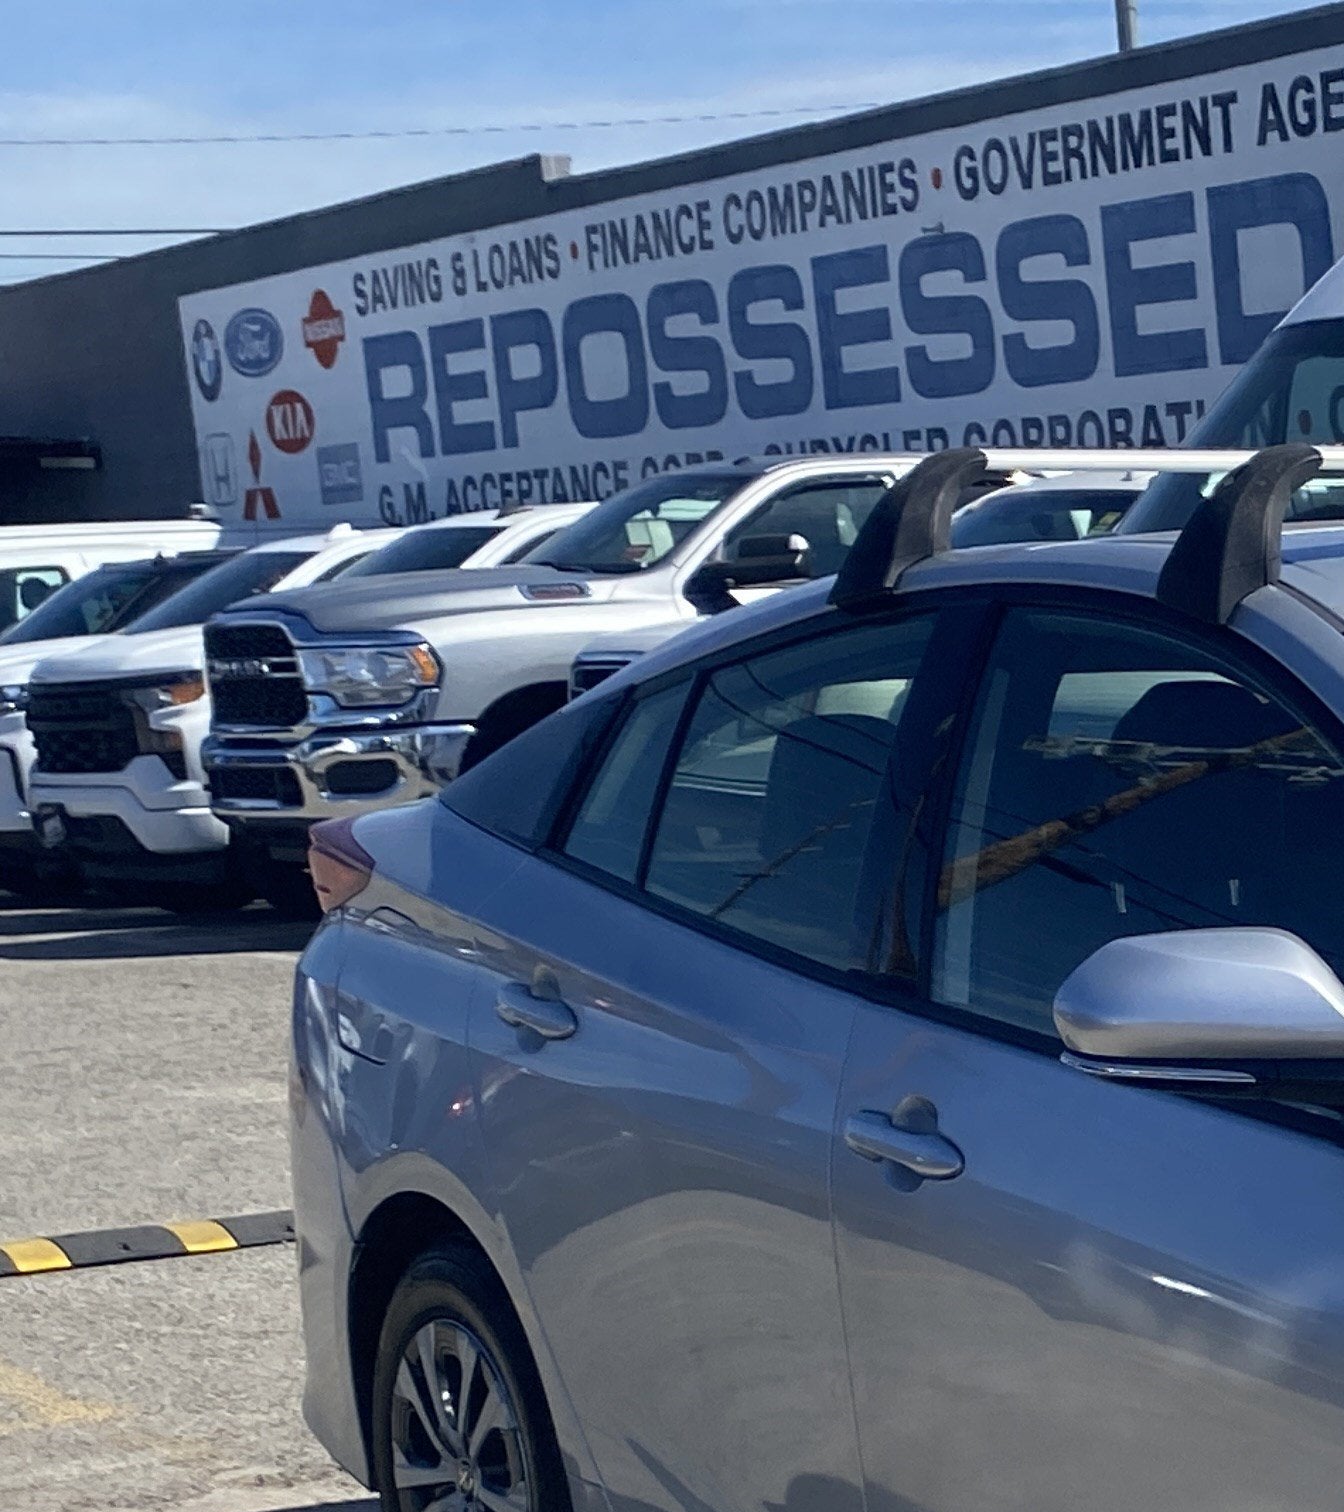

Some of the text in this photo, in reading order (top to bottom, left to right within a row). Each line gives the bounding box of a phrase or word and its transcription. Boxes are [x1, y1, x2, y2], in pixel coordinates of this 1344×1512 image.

[352, 258, 443, 317] SAVING
[474, 233, 562, 293] LOANS
[586, 199, 714, 271] FINANCE
[723, 157, 919, 246] COMPANIES
[954, 90, 1238, 201] GOVERNMENT
[362, 171, 1335, 464] REPOSSESSED
[446, 460, 629, 517] ACCEPTANCE
